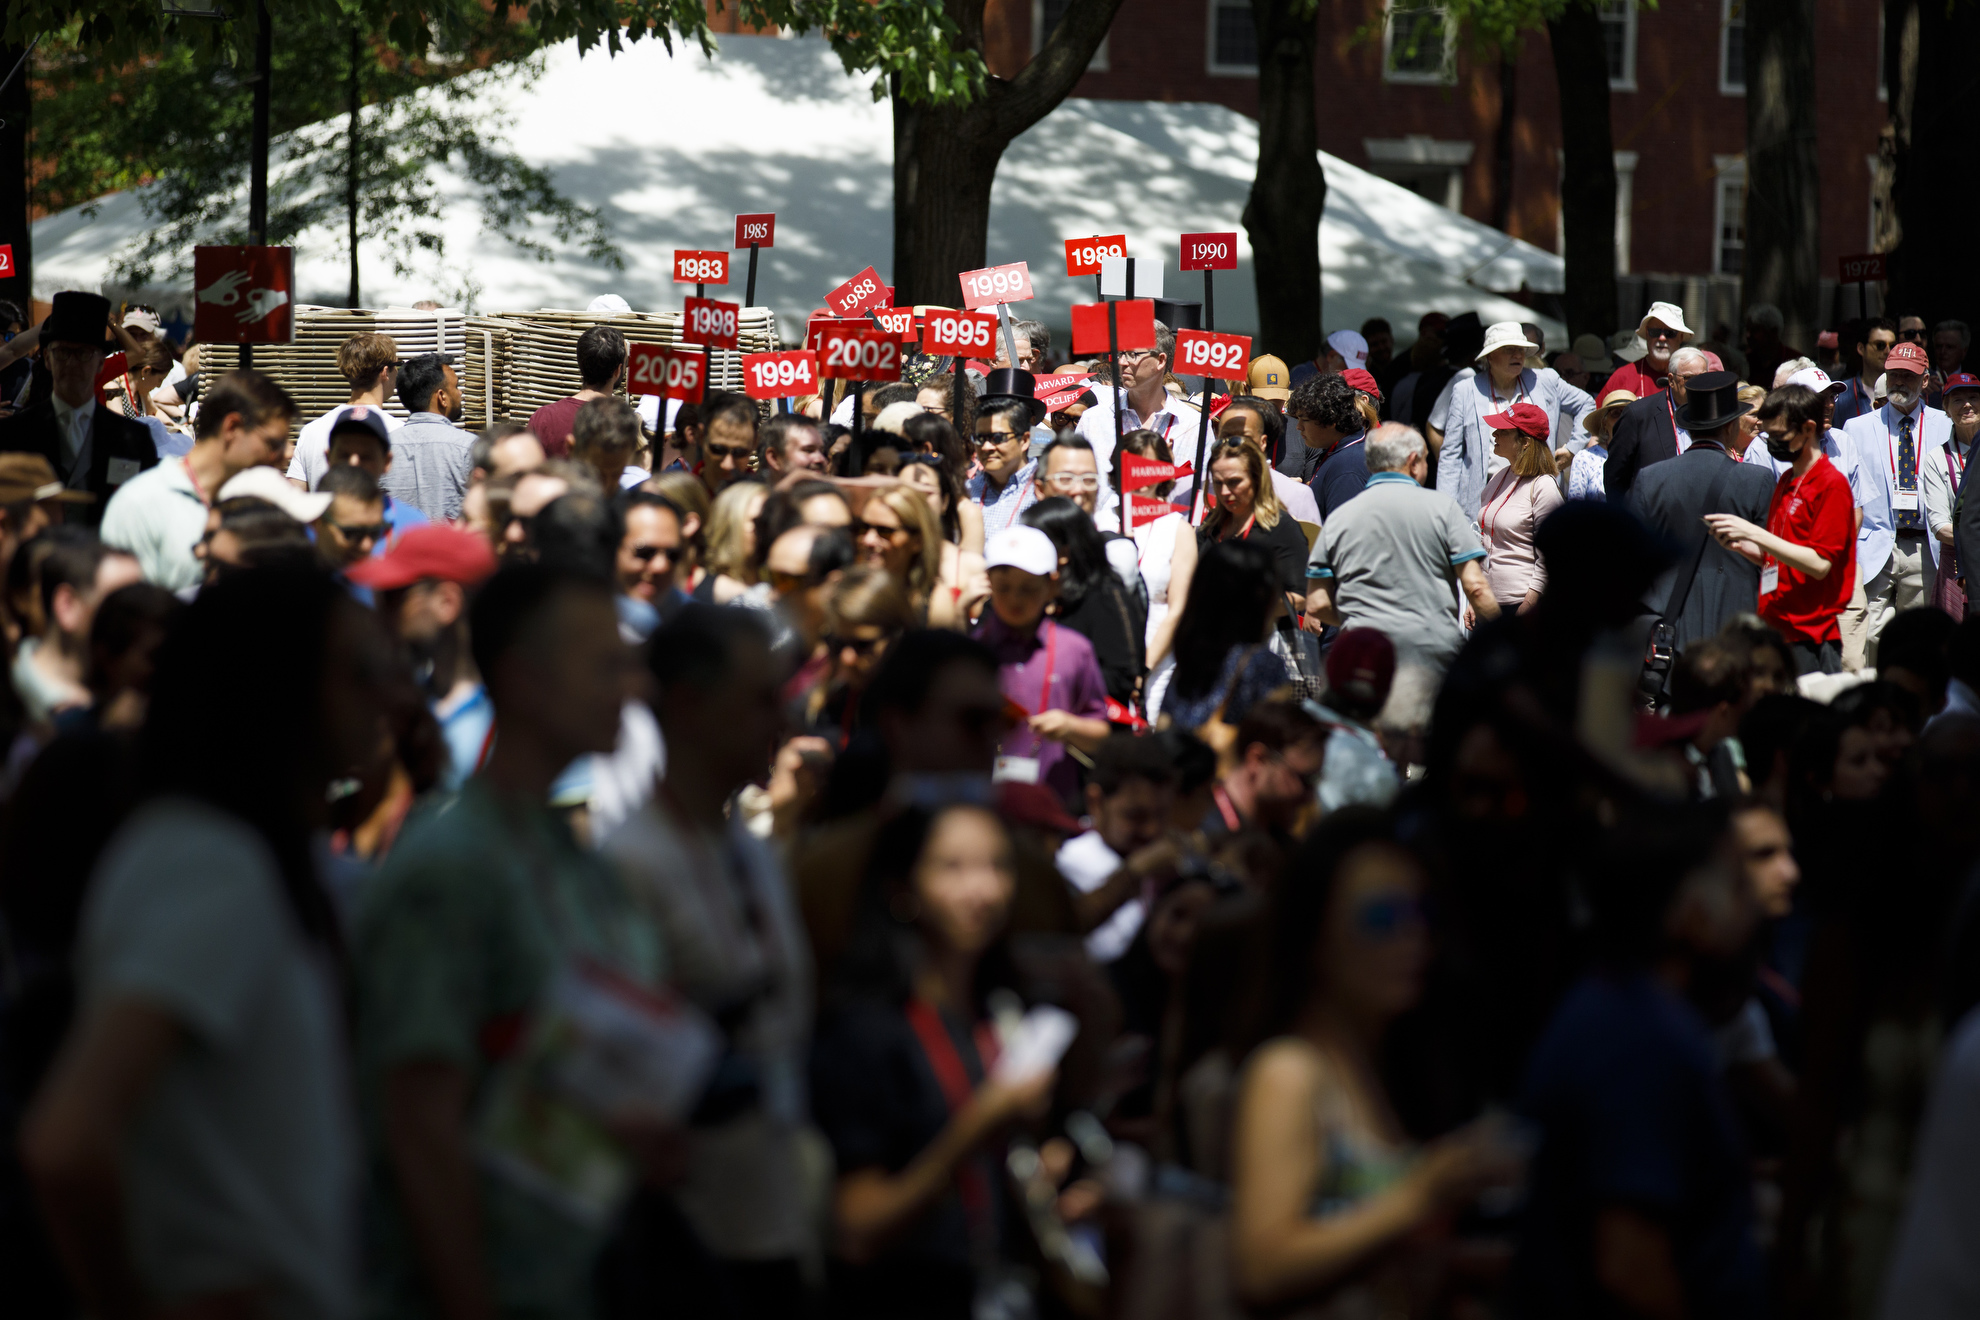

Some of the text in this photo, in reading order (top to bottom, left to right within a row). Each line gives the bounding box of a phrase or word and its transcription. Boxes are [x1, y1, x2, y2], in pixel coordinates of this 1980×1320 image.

[743, 223, 768, 239] 1985
[1072, 244, 1122, 266] 1989
[1192, 243, 1227, 260] 1990
[678, 259, 722, 279] 1983
[1844, 259, 1881, 277] 1972
[839, 278, 877, 311] 1988
[968, 270, 1024, 298] 1999
[690, 306, 736, 337] 1998
[931, 318, 990, 347] 1995
[827, 338, 896, 369] 2002
[1182, 339, 1243, 369] 1992
[634, 354, 699, 389] 2005
[751, 359, 812, 387] 1994
[1813, 370, 1828, 381] H
[1041, 390, 1080, 406] DCLIFFE
[1131, 465, 1175, 477] HARVARD
